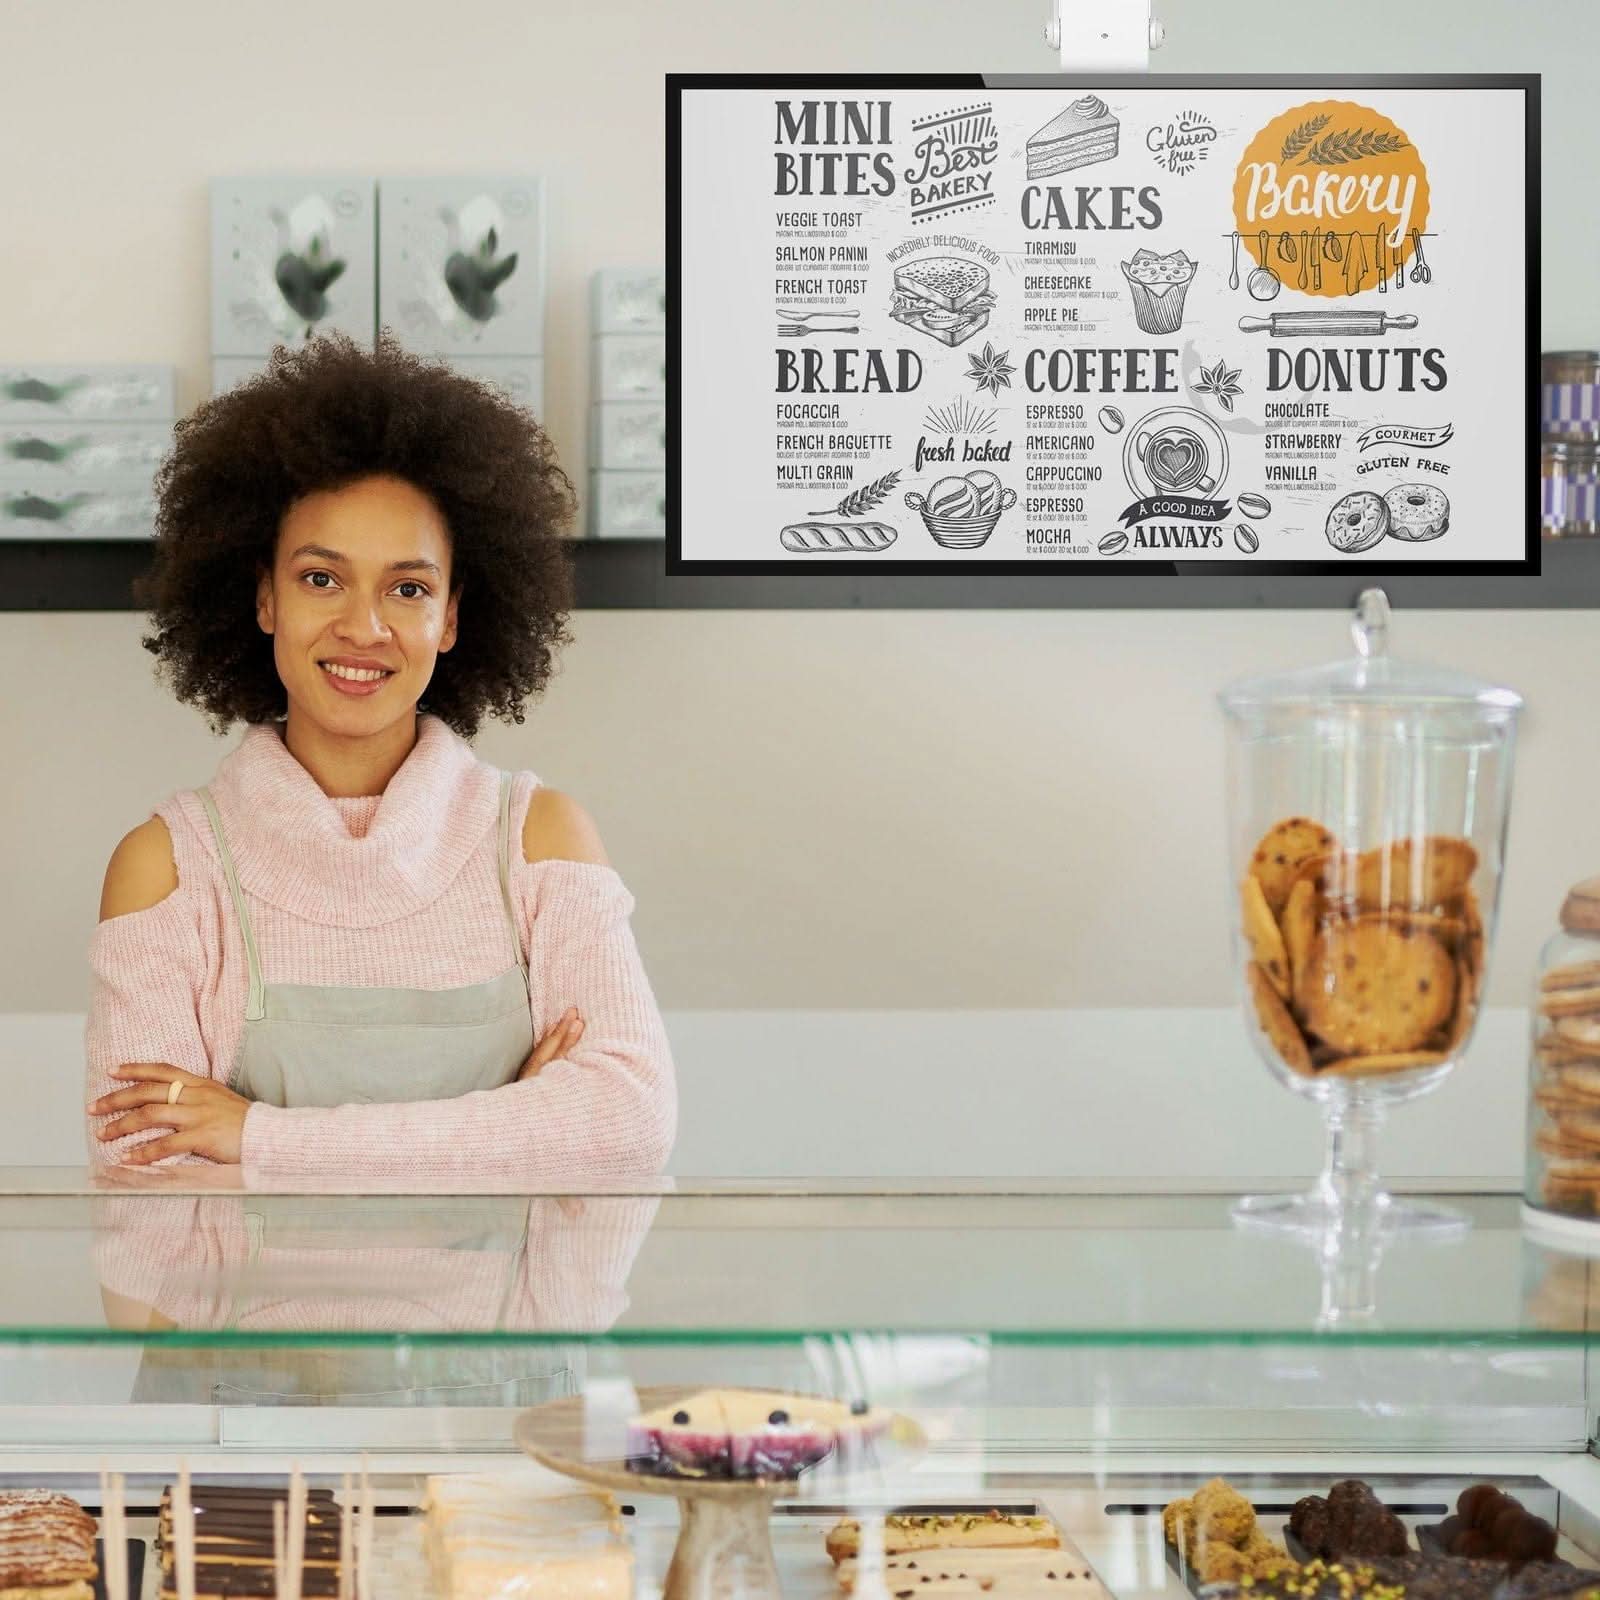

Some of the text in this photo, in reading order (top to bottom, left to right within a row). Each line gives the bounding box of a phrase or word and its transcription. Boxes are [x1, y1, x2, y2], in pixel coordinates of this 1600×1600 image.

[774, 101, 892, 145] MINI
[1146, 121, 1217, 152] Gluten
[904, 134, 999, 184] Best
[1168, 149, 1196, 173] free
[774, 153, 895, 197] BITES
[910, 171, 993, 206] BAKERY
[1021, 186, 1162, 230] CAKES
[1242, 161, 1416, 248] Bakery
[776, 212, 862, 227] VEGGIE TOAST
[776, 247, 867, 261] SALMON PANINI
[886, 236, 930, 263] INCREDIBLY
[933, 235, 977, 253] DELICIOUS
[977, 244, 1001, 266] FOOD
[1025, 241, 1076, 255] TIRAMISU
[776, 279, 867, 294] FRENCH TOAST
[1025, 276, 1091, 290] CHEESECAKE
[1025, 308, 1078, 321] APPLE PIE
[775, 349, 922, 393] BREAD
[1025, 349, 1178, 392] COFFEE
[1266, 348, 1447, 392] DONUTS
[777, 404, 839, 419] FOCACCIA
[1027, 405, 1083, 419] ESPRESSO
[1265, 403, 1330, 419] CHOCOLATE
[777, 434, 892, 450] FRENCH BAGUETTE
[1027, 436, 1094, 450] AMERICANO
[1265, 434, 1341, 449] STRAWBERRY
[1375, 429, 1437, 443] GOURMET
[914, 436, 1013, 473] fresh baked
[777, 465, 853, 480] MULTI GRAIN
[1026, 466, 1102, 481] CAPPUCCINO
[1265, 466, 1316, 480] VANILLA
[1356, 457, 1451, 475] GLUTEN FREE
[1026, 498, 1083, 512] ESPRESSO
[1139, 501, 1216, 516] A GOOD IDEA
[1027, 528, 1070, 544] MOCHA
[1133, 526, 1223, 548] ALWAYS
